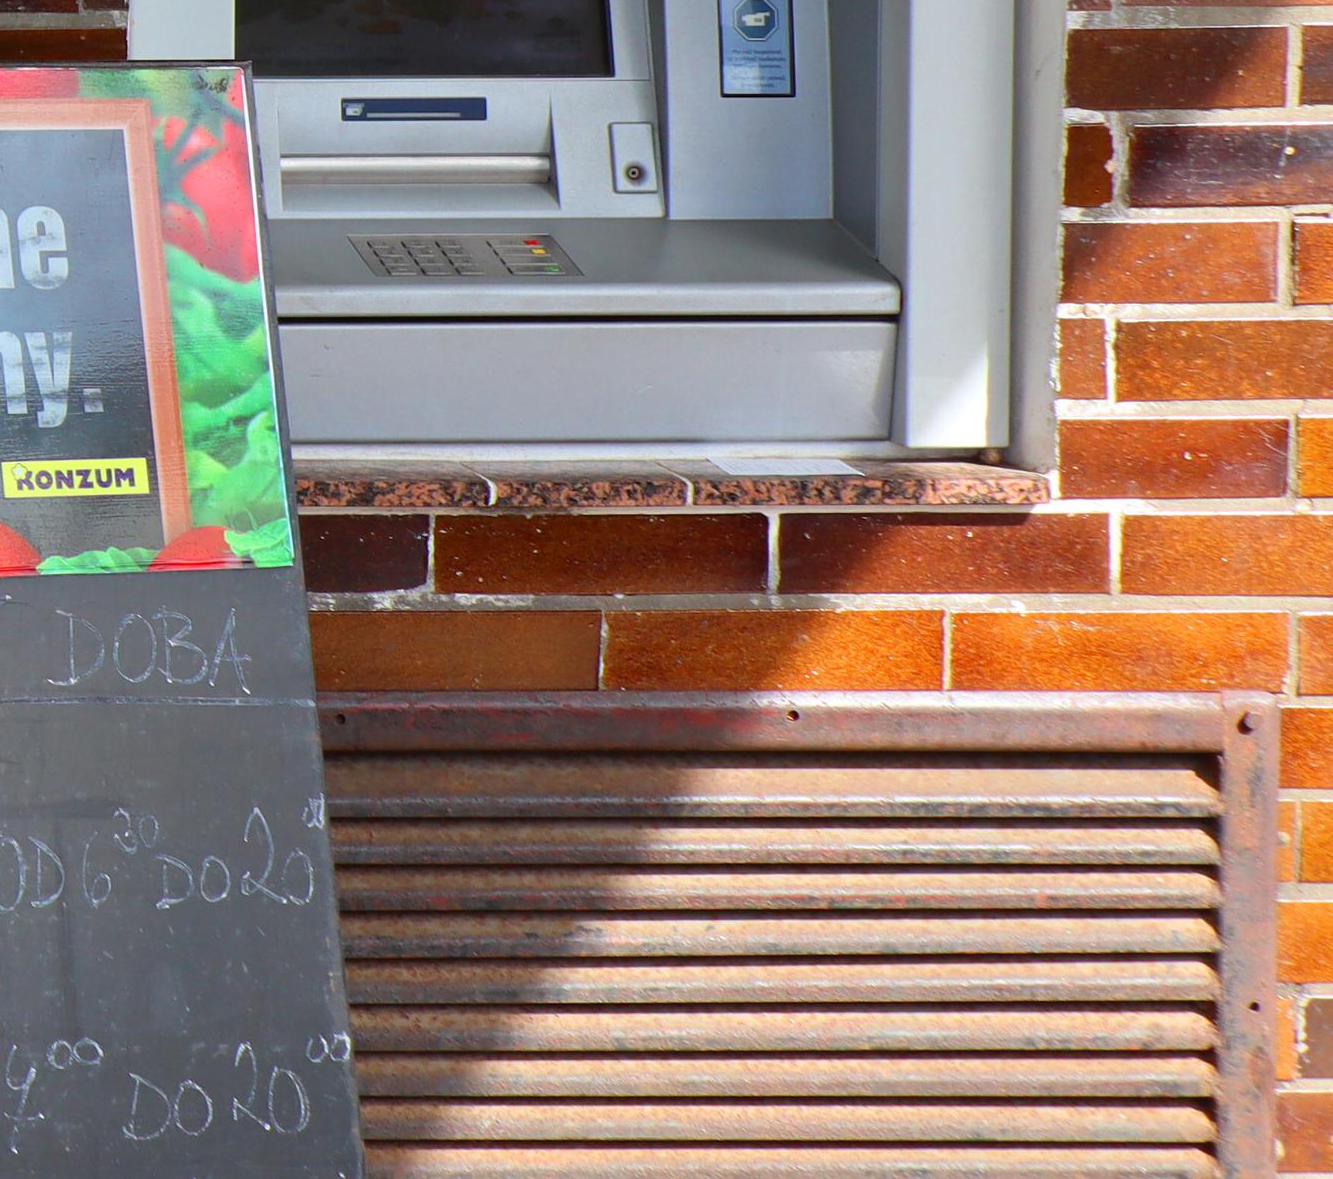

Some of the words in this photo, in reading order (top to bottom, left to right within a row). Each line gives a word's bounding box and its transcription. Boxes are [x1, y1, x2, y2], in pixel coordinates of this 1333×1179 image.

[13, 466, 135, 492] KONZUM
[48, 605, 252, 695] DOBA
[155, 853, 231, 910] DO
[123, 1072, 214, 1142] DO
